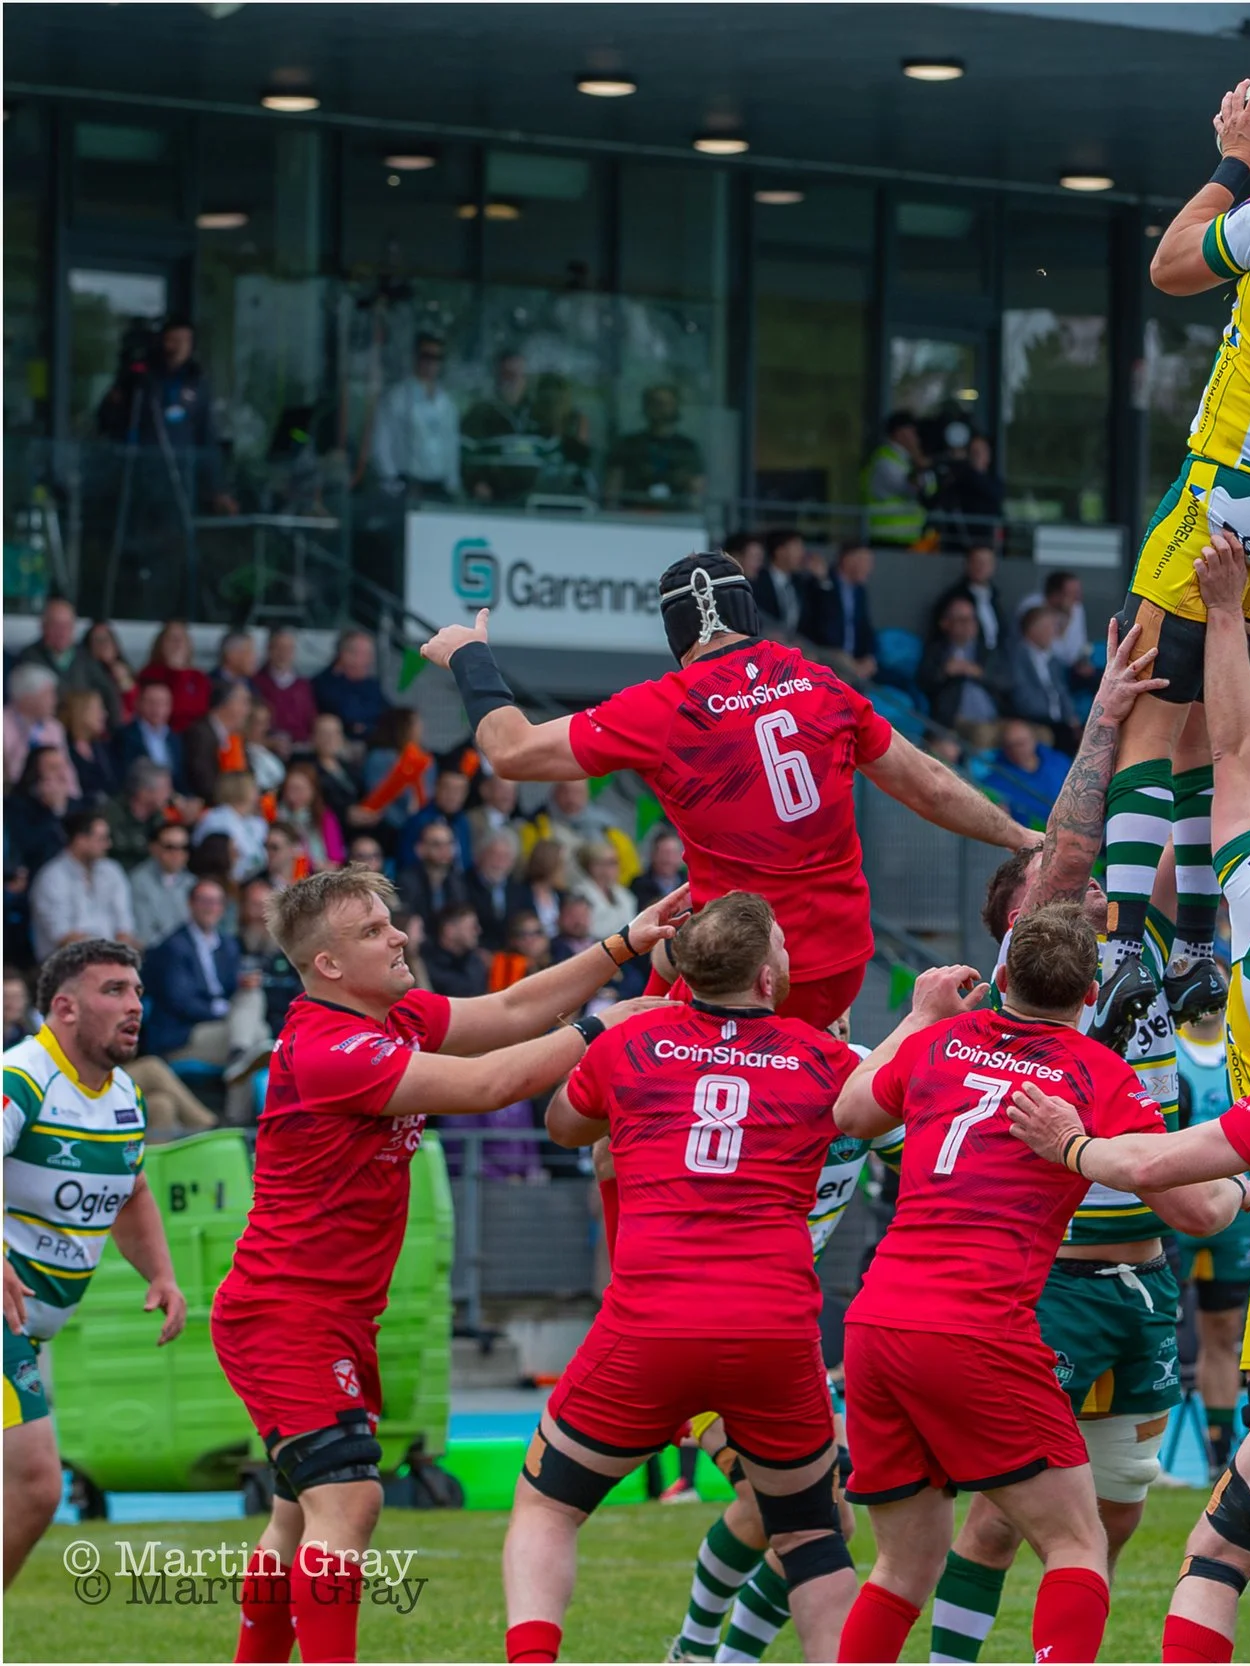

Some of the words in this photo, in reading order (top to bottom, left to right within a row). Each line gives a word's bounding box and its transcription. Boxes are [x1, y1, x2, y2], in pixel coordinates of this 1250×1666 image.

[506, 559, 661, 616] Garenne
[706, 675, 813, 715] CoinShares
[754, 709, 821, 824] 6
[654, 1038, 800, 1071] CoinShares
[945, 1038, 1064, 1083] CoinShares
[684, 1073, 750, 1175] 8
[933, 1071, 1013, 1175] 7
